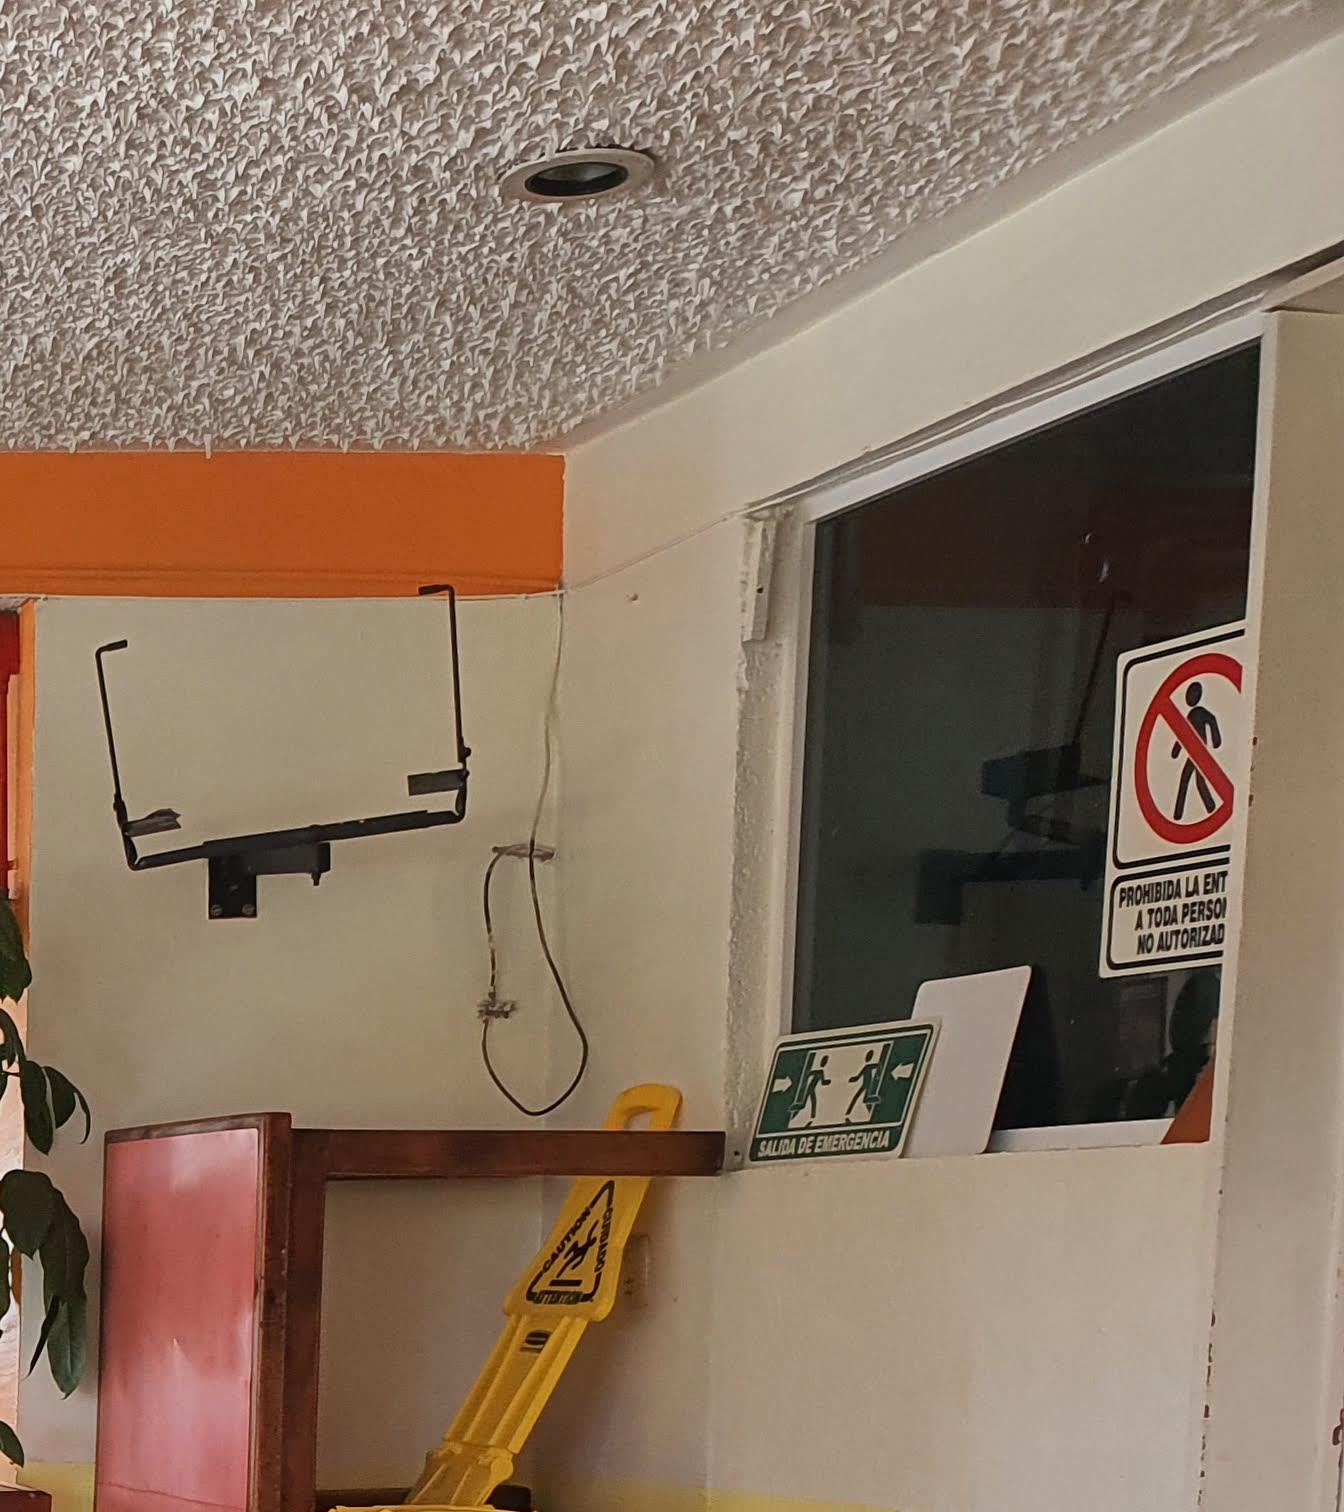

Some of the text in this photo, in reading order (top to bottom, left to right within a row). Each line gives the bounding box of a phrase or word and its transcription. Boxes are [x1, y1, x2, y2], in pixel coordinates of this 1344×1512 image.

[1118, 878, 1182, 908] PROHIBIDA
[1185, 875, 1199, 898] LA
[1134, 909, 1144, 931] A
[1147, 904, 1178, 929] TODA
[1136, 923, 1225, 955] NO AUTORIZAD
[758, 1130, 890, 1157] SALIDA DE EMERGENCIA
[542, 1207, 591, 1273] CAUTION
[594, 1207, 613, 1273] CUIDADO
